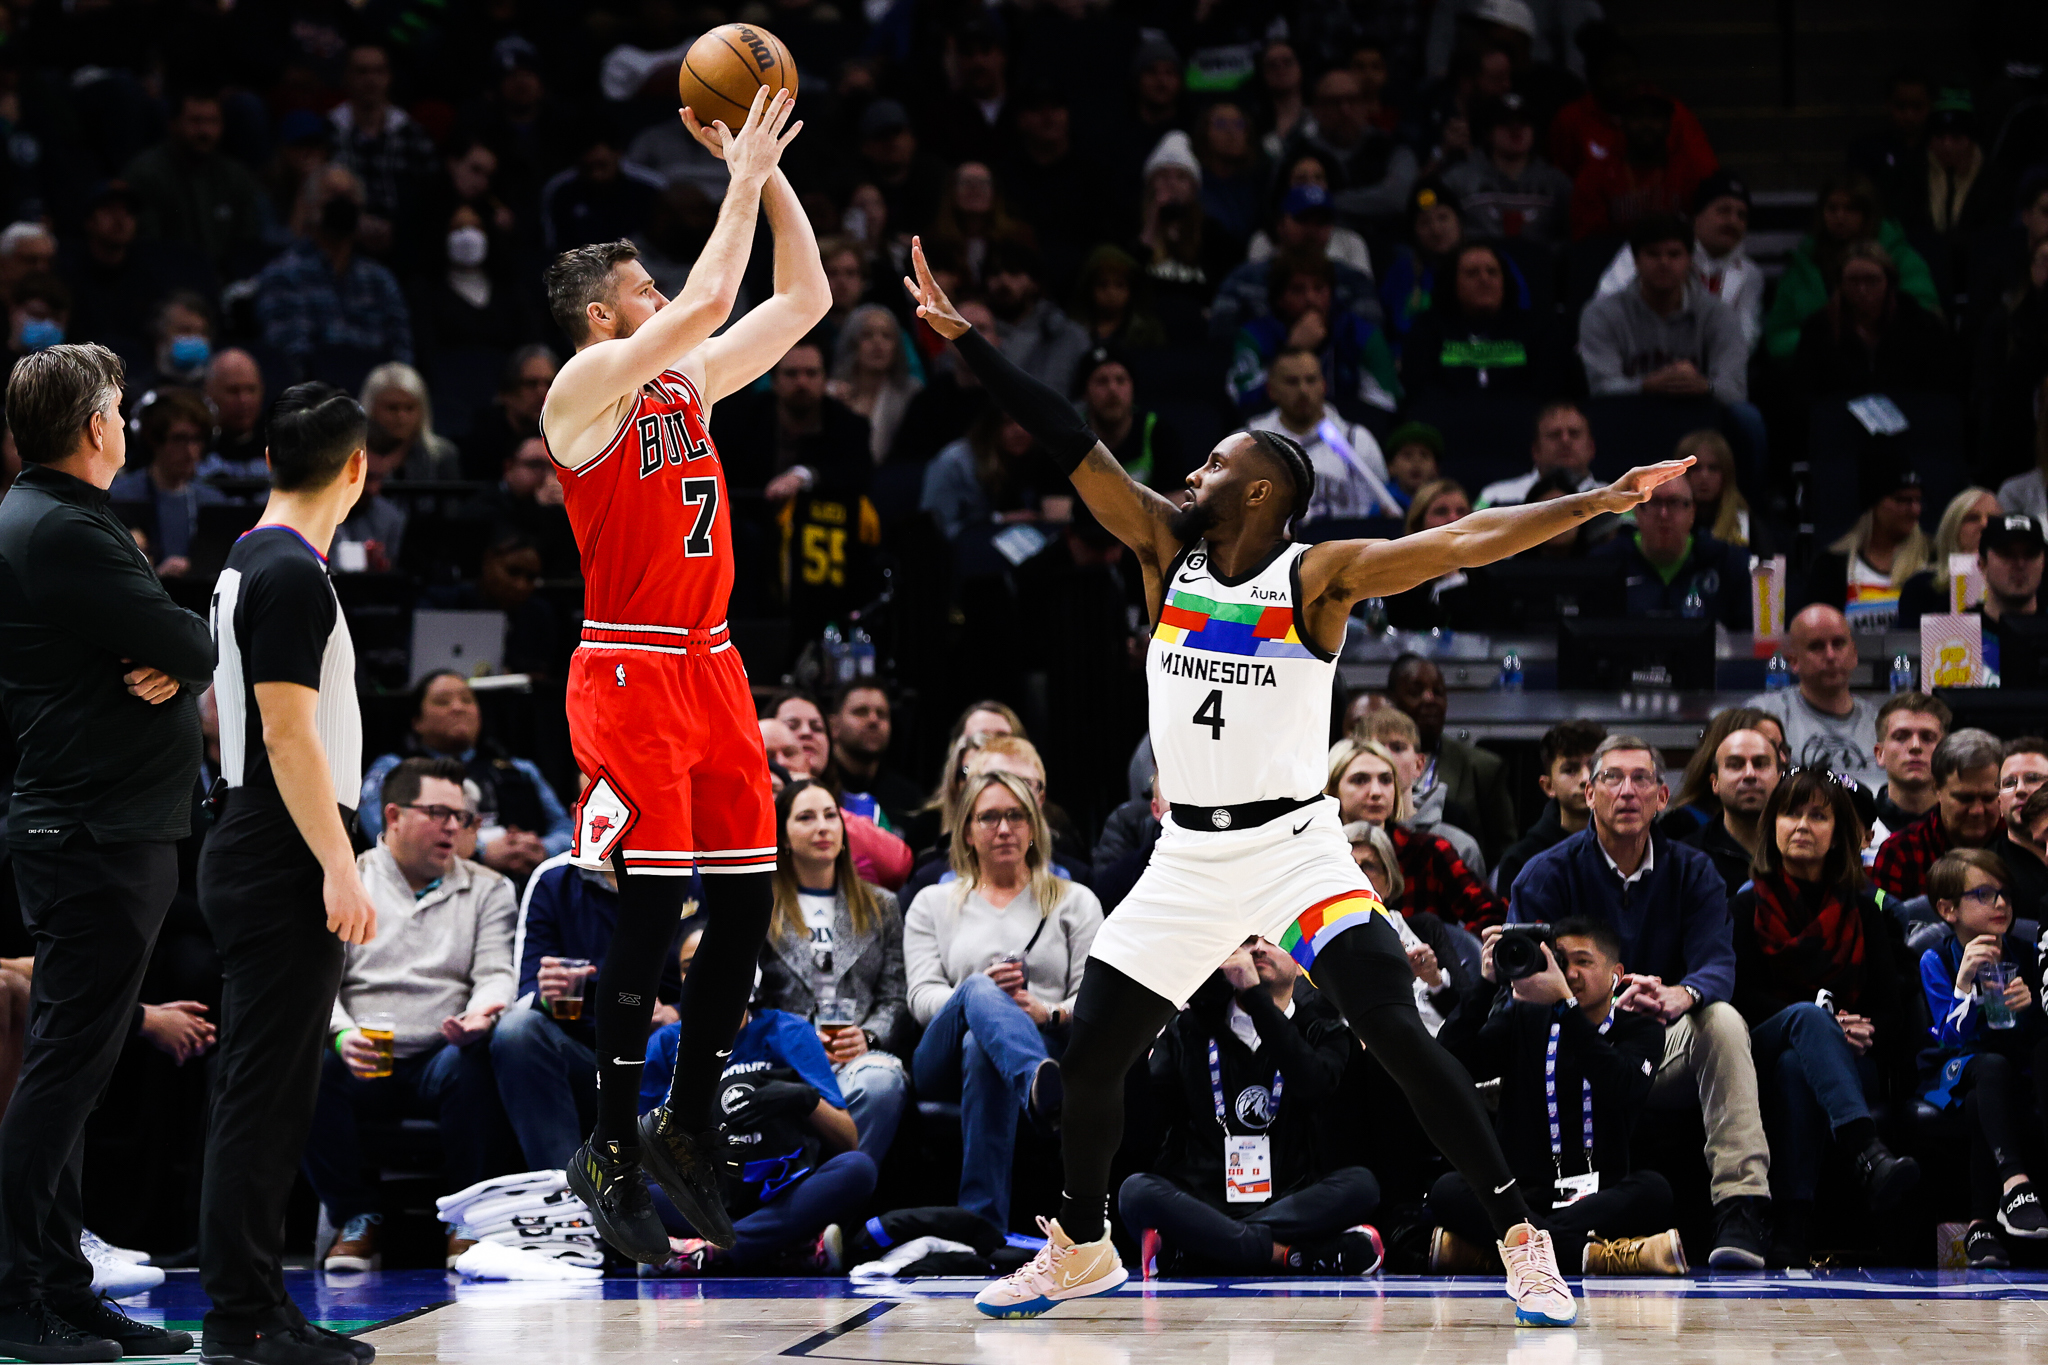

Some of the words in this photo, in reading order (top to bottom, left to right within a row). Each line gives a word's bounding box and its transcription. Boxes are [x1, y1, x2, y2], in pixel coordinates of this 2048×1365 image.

[636, 410, 718, 480] BUL
[681, 476, 719, 558] 7
[1161, 651, 1277, 687] MINNESOTA
[1193, 690, 1225, 740] 4
[2006, 1192, 2039, 1214] adid
[1967, 1230, 1995, 1251] adid
